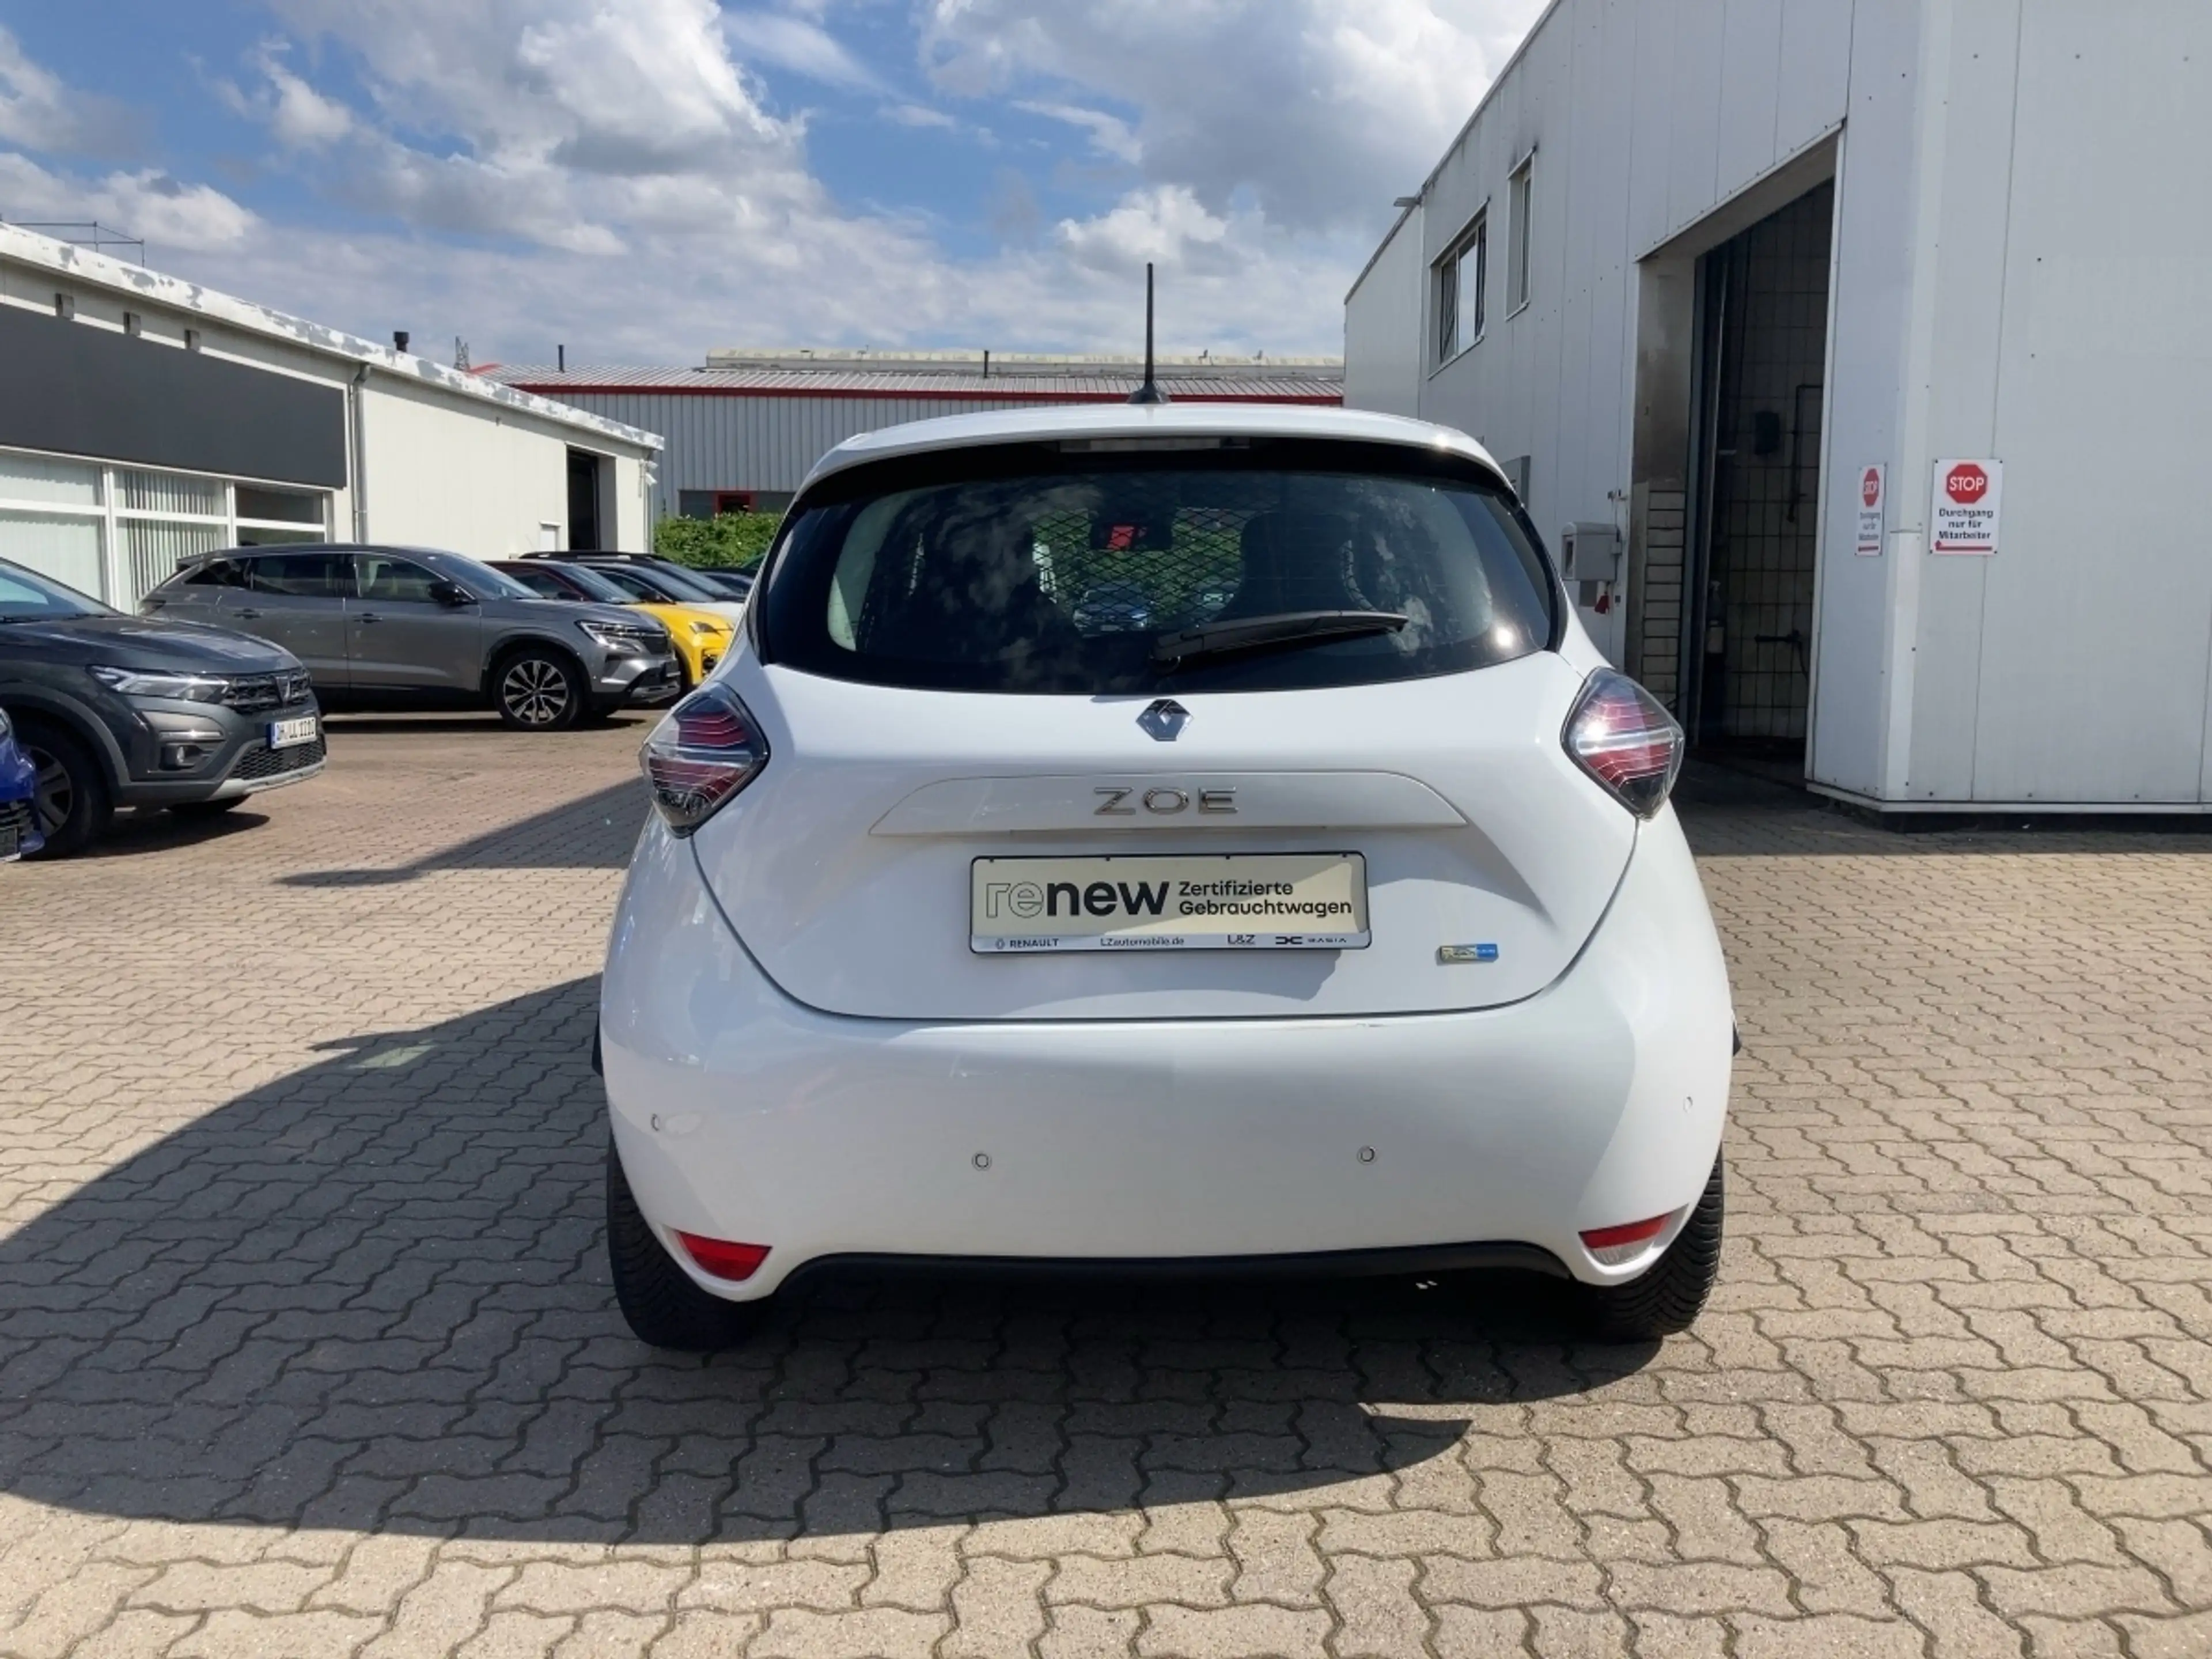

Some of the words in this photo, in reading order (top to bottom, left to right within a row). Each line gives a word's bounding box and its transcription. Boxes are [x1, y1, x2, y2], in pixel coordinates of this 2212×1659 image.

[1949, 476, 1984, 491] STOP
[1939, 507, 1994, 518] Durchgang
[1968, 519, 1982, 528] für
[1939, 531, 1991, 539] Mitarbeiter
[1093, 787, 1238, 815] ZOE
[1179, 880, 1293, 896] Zertifizierte
[986, 881, 1170, 918] renew
[1179, 899, 1352, 918] Gebrauchtwagen
[1009, 938, 1059, 948] RENAULT
[1100, 937, 1185, 946] LZautomobile.de
[1227, 934, 1256, 945] L&Z
